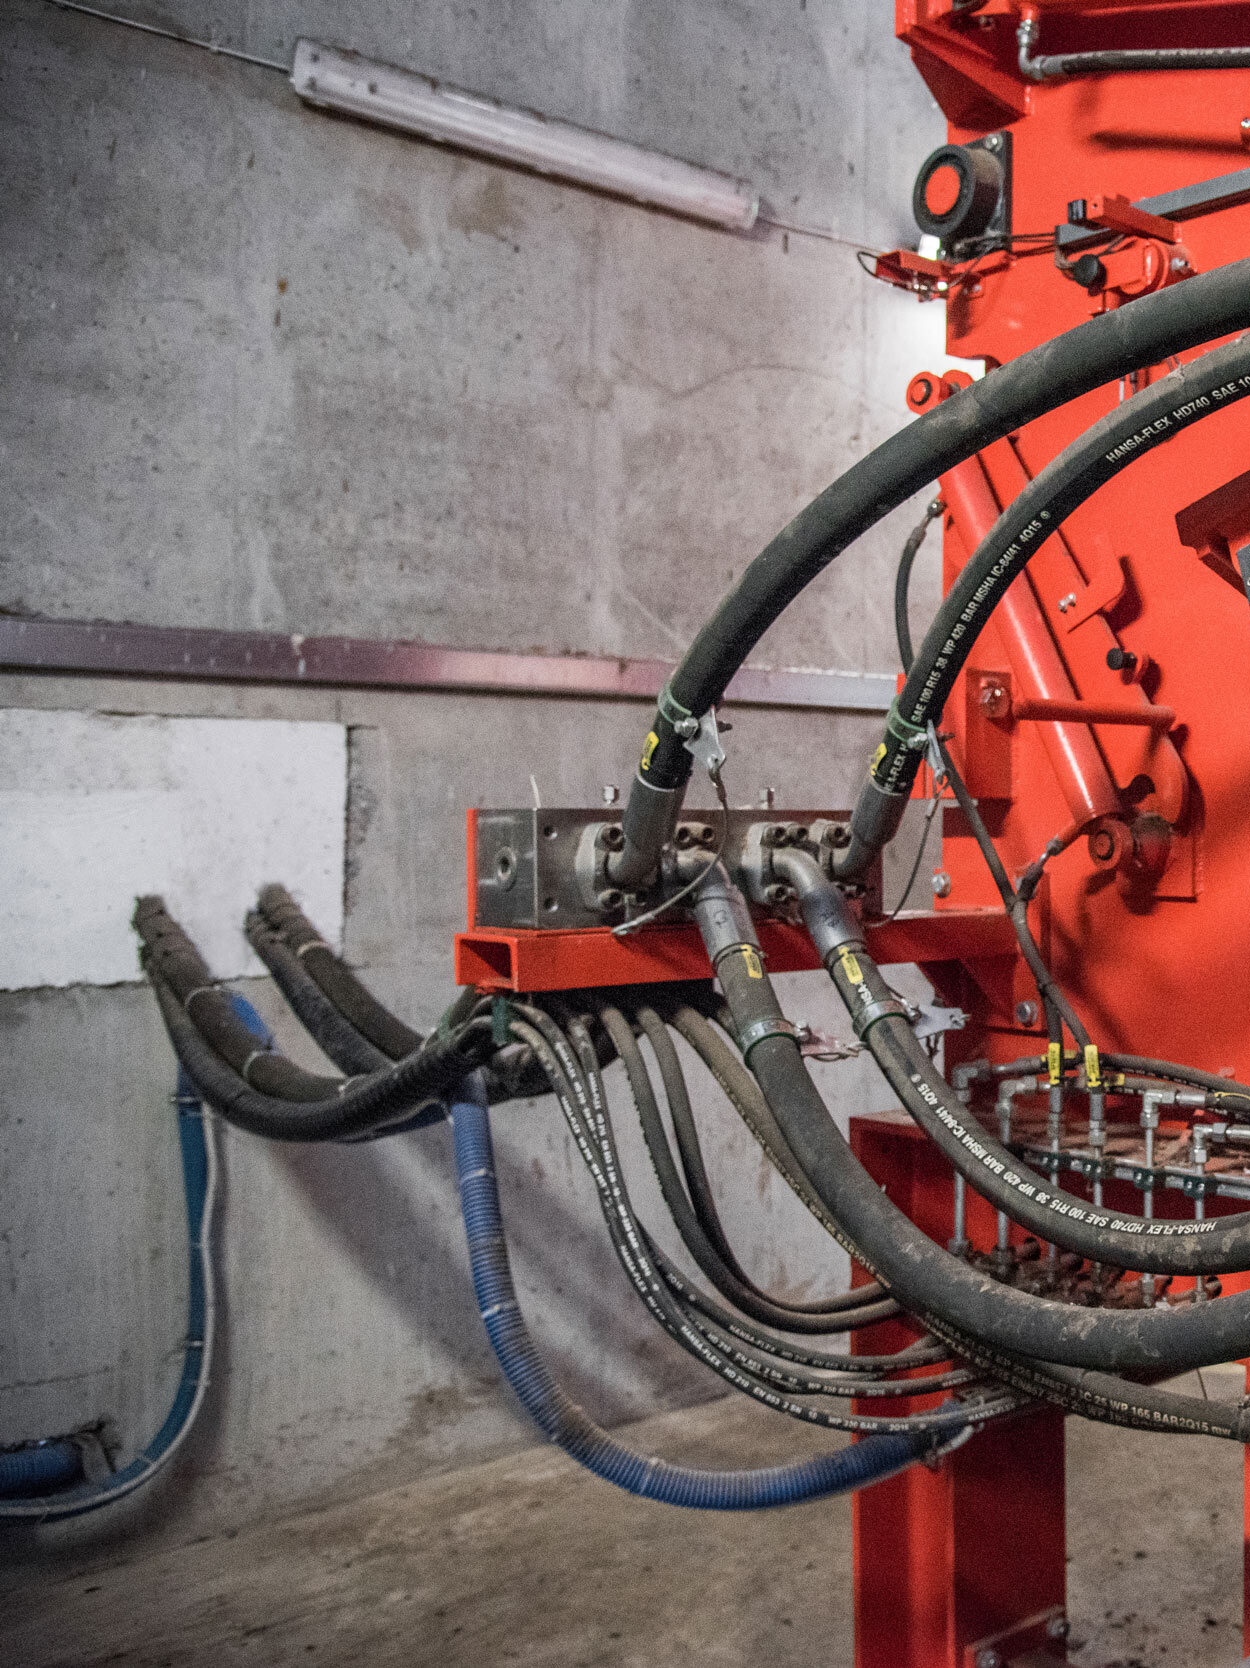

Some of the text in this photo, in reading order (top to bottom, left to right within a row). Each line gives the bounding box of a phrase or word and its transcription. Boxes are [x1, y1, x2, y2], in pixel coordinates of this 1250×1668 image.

[1106, 416, 1174, 463] HANSA-FLEX
[1173, 397, 1210, 421] HD740
[1212, 383, 1240, 401] SAE
[911, 703, 926, 723] SAE
[919, 688, 933, 703] 100
[926, 671, 941, 689] R15
[936, 657, 948, 669] 38
[942, 639, 957, 655] WP
[951, 624, 966, 640] 420
[960, 601, 979, 622] BAR
[973, 576, 997, 603] MSHA
[962, 1133, 988, 1159] MSHA
[983, 1154, 1005, 1174] BAR
[1003, 1171, 1021, 1186] 420
[1018, 1183, 1036, 1197] WP
[1035, 1192, 1050, 1204] 38
[1050, 1199, 1070, 1214] R15
[1069, 1207, 1087, 1220] 100
[1087, 1214, 1110, 1226] SAE
[1110, 1219, 1144, 1233] HD740
[1147, 1221, 1217, 1235] HANSA-FLEX
[1108, 1398, 1128, 1412] WP
